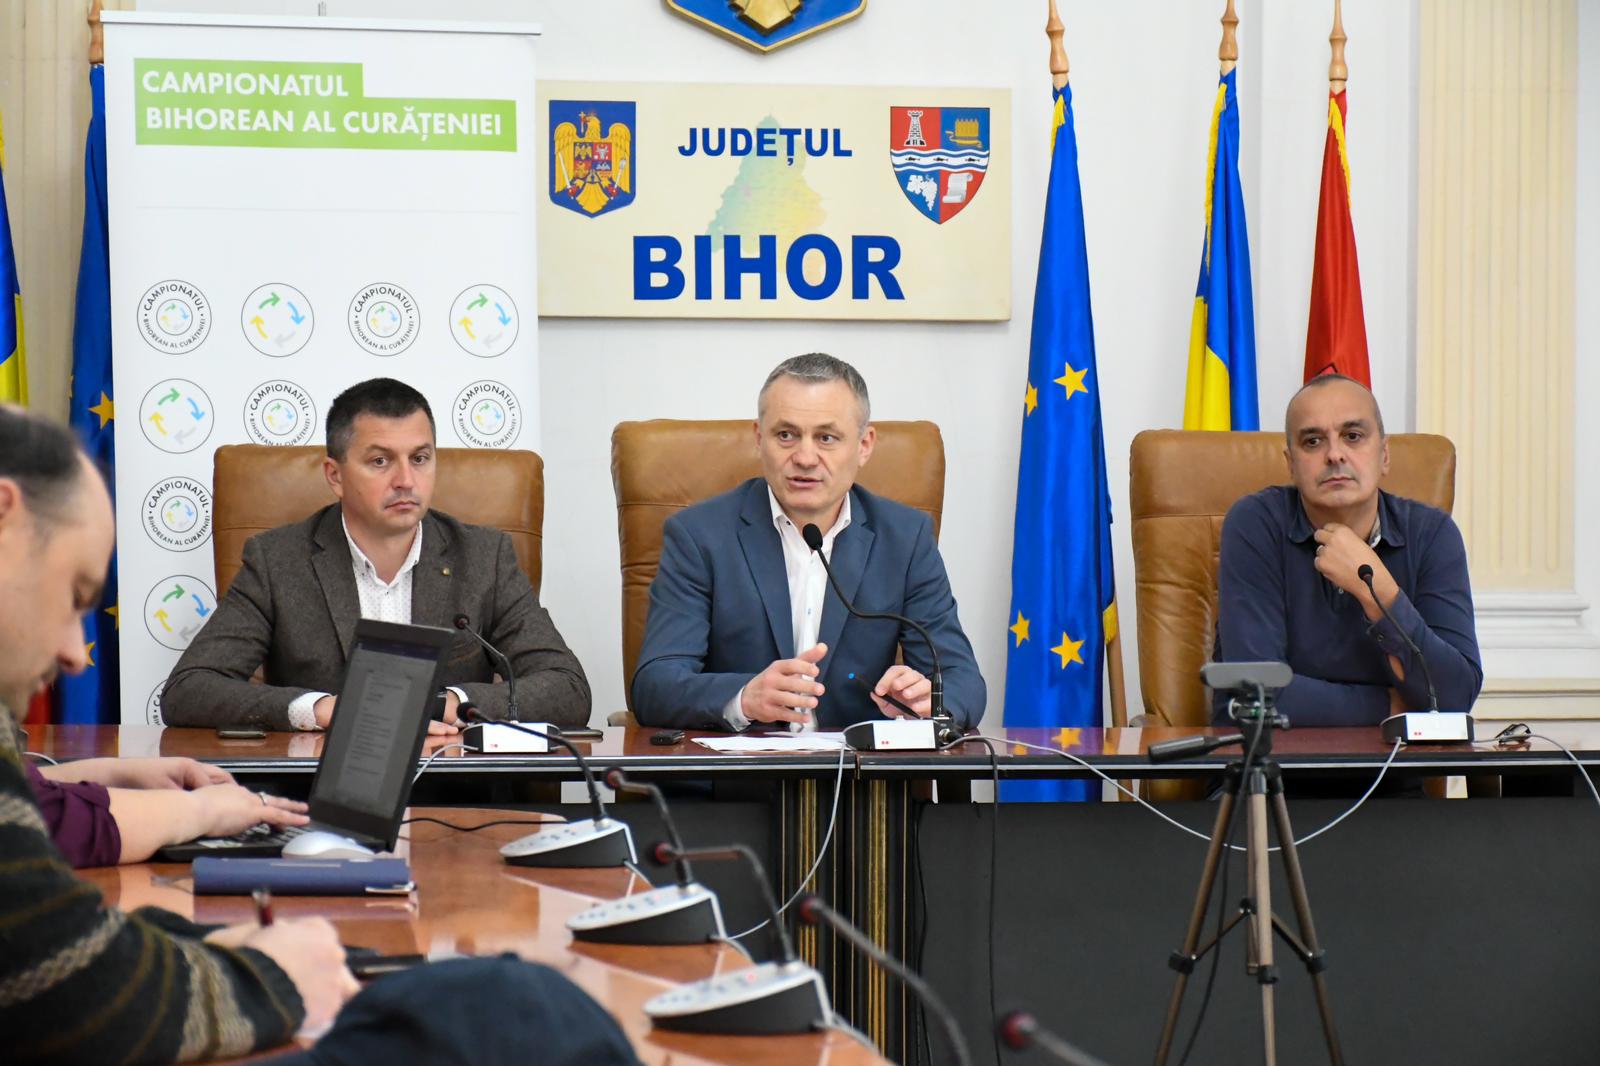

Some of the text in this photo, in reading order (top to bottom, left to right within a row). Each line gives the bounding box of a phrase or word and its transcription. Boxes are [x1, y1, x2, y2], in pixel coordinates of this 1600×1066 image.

[142, 70, 348, 97] CAMPIONATUL
[146, 105, 501, 141] BIHOREAN AL CURĂȚENIEI
[677, 127, 853, 165] JUDEȚUL
[633, 233, 905, 301] BIHOR
[144, 284, 204, 311] CAMPIONATUL
[354, 286, 413, 313] CAMPIONATUL
[143, 318, 168, 346] BIHOREAN
[354, 320, 378, 348] BIHOREAN
[250, 384, 309, 411] CAMPIONATUL
[459, 384, 515, 411] CAMPIONATUL
[458, 418, 483, 446] BIHOREAN
[149, 480, 209, 508] CAMPIONATUL
[148, 516, 173, 544] BIHOREAN
